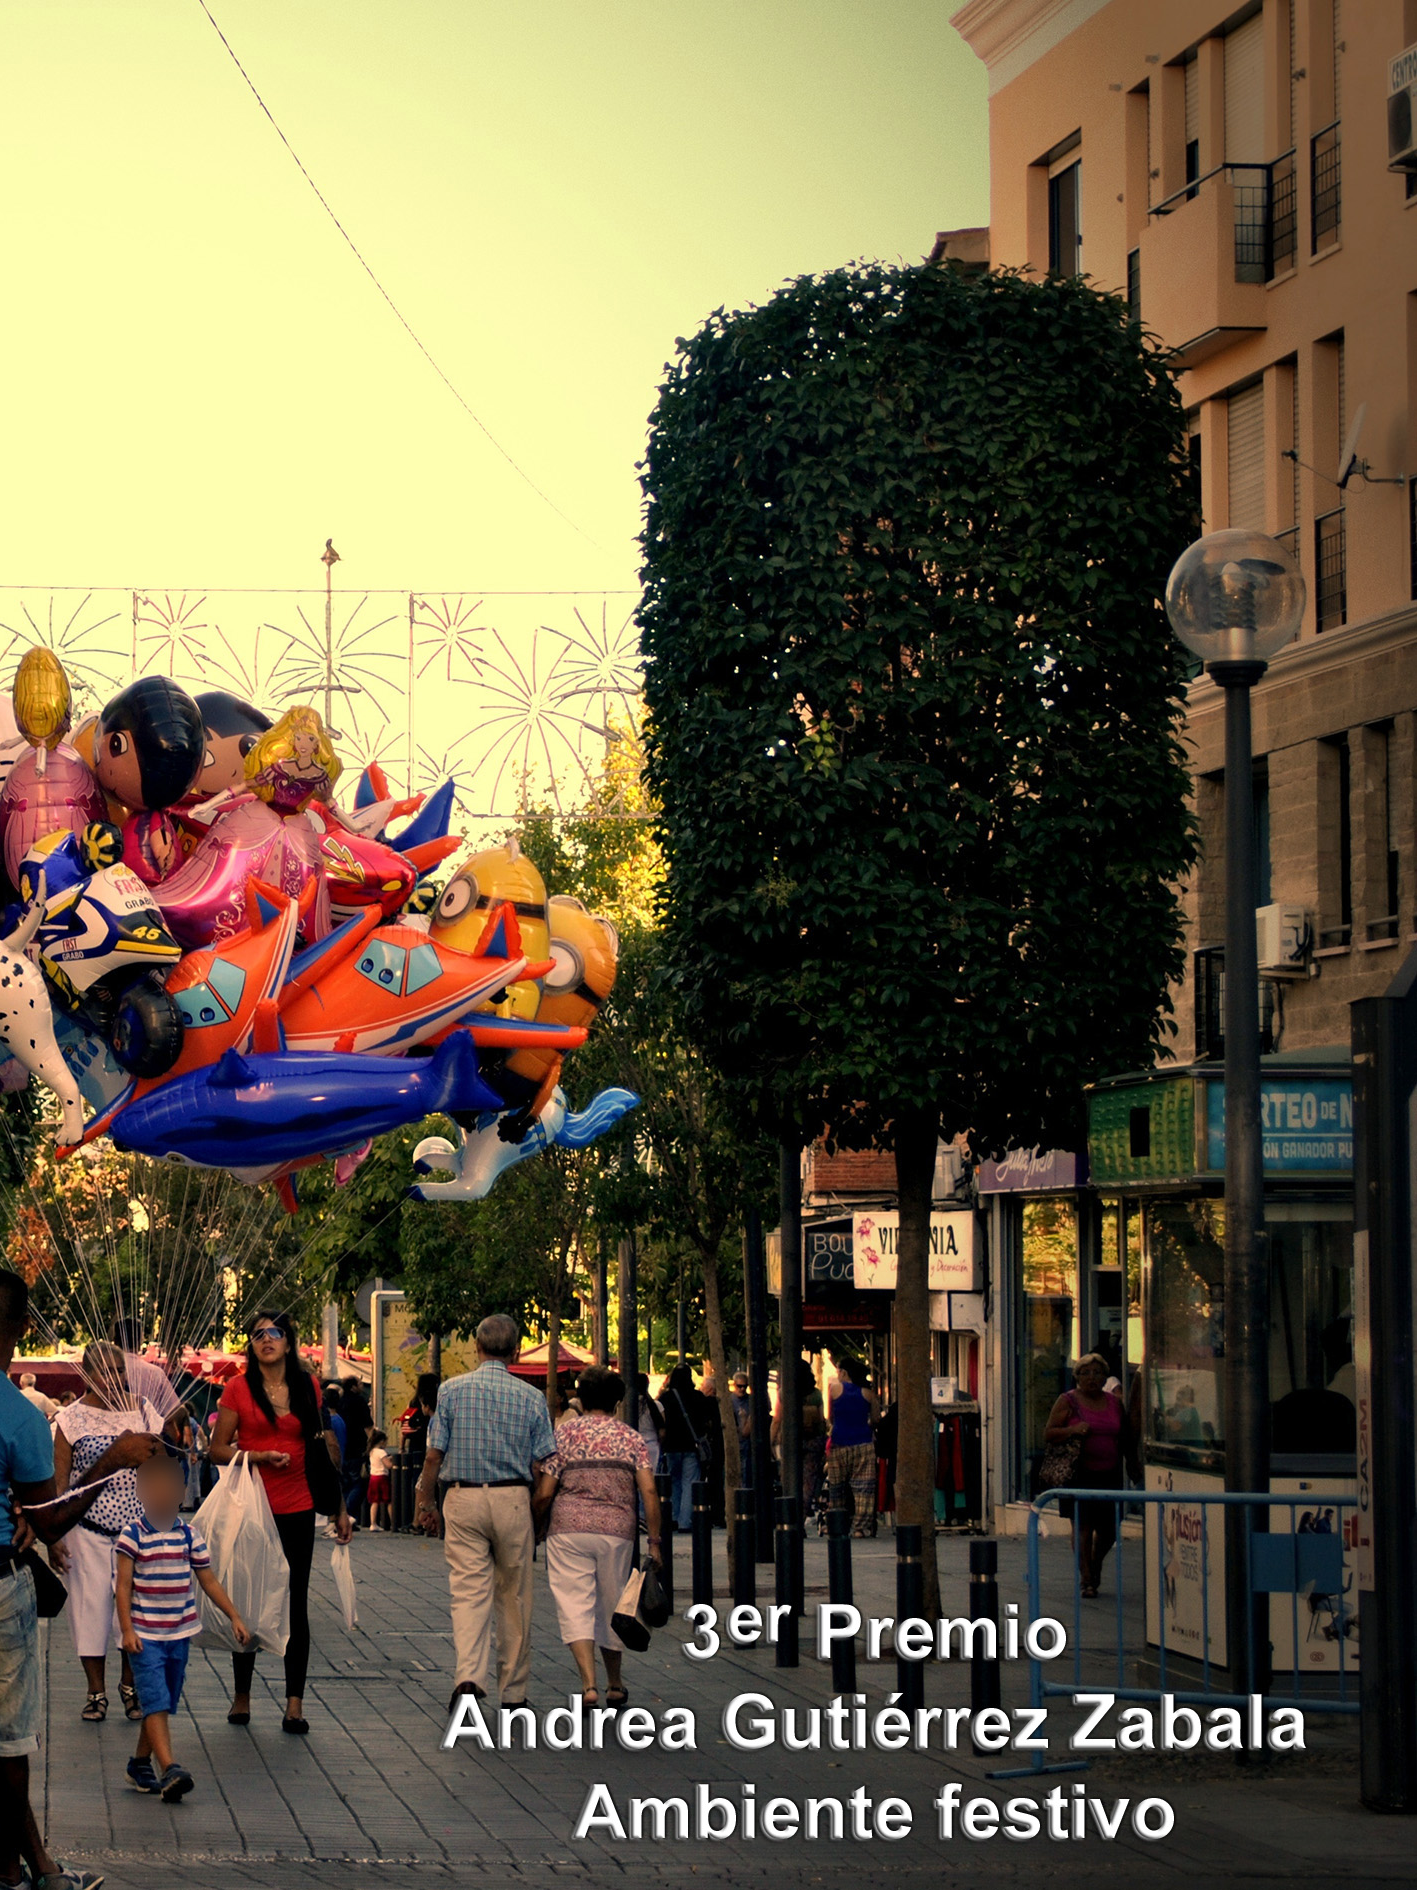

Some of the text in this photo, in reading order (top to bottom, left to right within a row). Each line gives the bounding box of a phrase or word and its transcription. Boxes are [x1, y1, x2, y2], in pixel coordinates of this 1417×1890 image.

[1320, 1101, 1337, 1120] DE
[1282, 1142, 1335, 1159] GANADOR
[814, 1233, 854, 1256] BOU
[1359, 1398, 1369, 1512] CA2M
